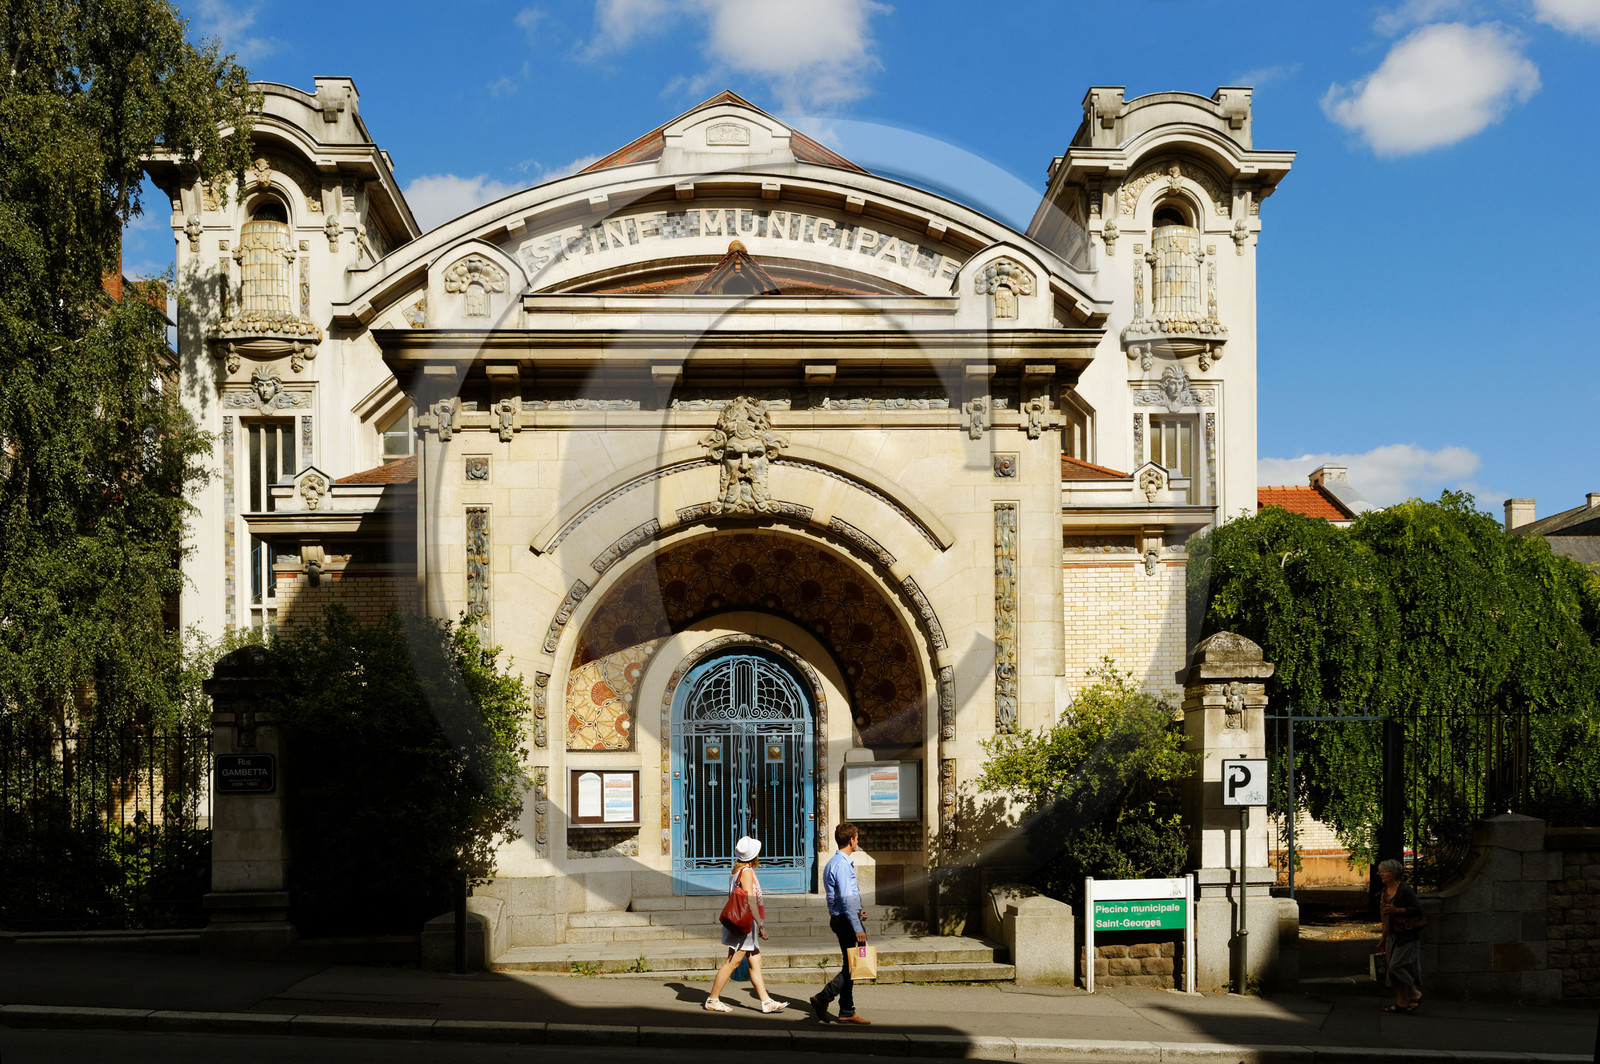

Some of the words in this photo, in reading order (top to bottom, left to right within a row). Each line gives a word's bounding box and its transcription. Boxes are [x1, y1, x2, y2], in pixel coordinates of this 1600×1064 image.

[514, 210, 662, 274] ISCINE
[699, 208, 962, 283] MUNICIPALE
[222, 768, 268, 776] GAMBETTA
[1095, 905, 1129, 914] Piscine
[1130, 903, 1181, 913] municipale
[1095, 919, 1162, 929] Saint-Georges
